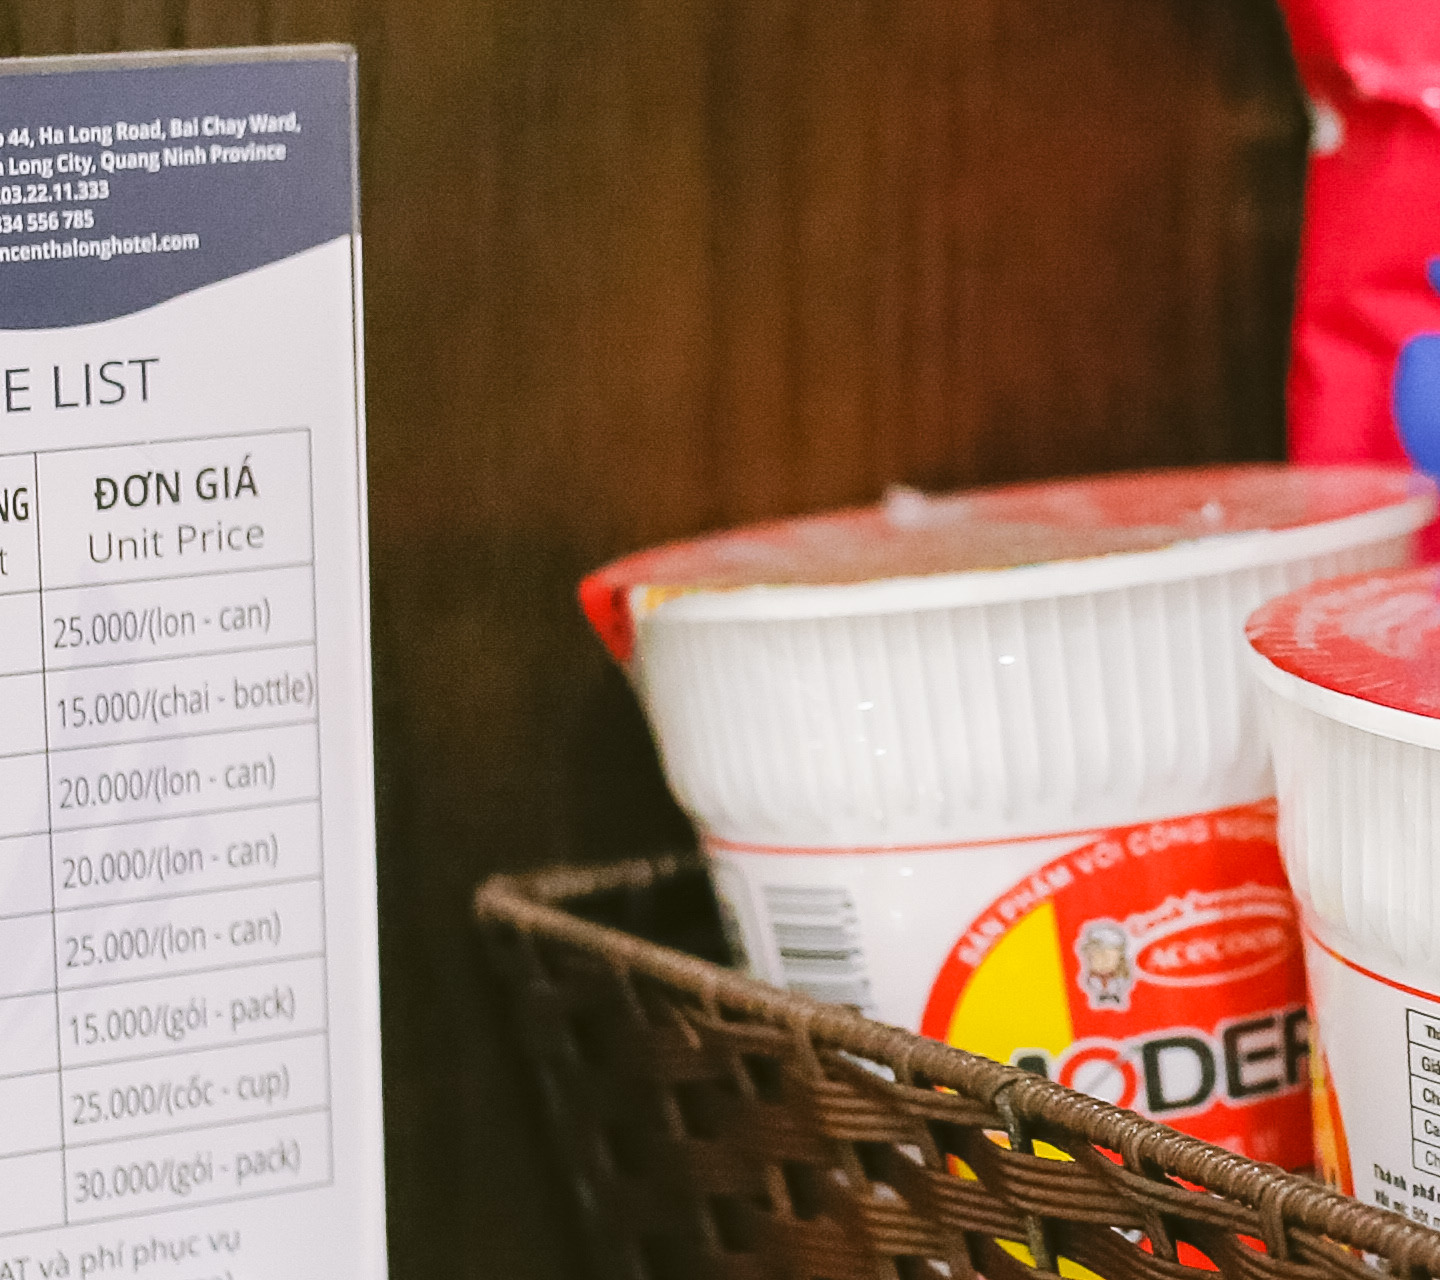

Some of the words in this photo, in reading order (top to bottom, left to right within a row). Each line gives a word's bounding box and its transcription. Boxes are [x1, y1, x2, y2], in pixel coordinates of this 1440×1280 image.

[7, 128, 34, 148] 44,
[39, 126, 64, 145] Ha
[69, 124, 112, 146] Long
[117, 122, 166, 141] Road,
[170, 119, 199, 138] Bai
[203, 116, 246, 138] Chay
[249, 113, 300, 134] Ward,
[9, 157, 52, 178] Long
[57, 154, 96, 175] City,
[101, 151, 160, 173] Quang
[164, 146, 206, 167] Ninh
[210, 143, 286, 163] Province
[27, 212, 59, 232] 556
[63, 210, 93, 229] 785
[54, 358, 159, 408] LIST
[94, 470, 180, 510] ĐƠN
[196, 455, 258, 500] GIÁ
[88, 530, 163, 563] Unit
[177, 524, 264, 556] Price
[219, 598, 271, 632] can)
[234, 672, 314, 708] bottle)
[224, 755, 276, 790] can)
[228, 834, 278, 869] can)
[231, 912, 281, 947] can)
[39, 1250, 70, 1278] và
[79, 1240, 124, 1280] phí
